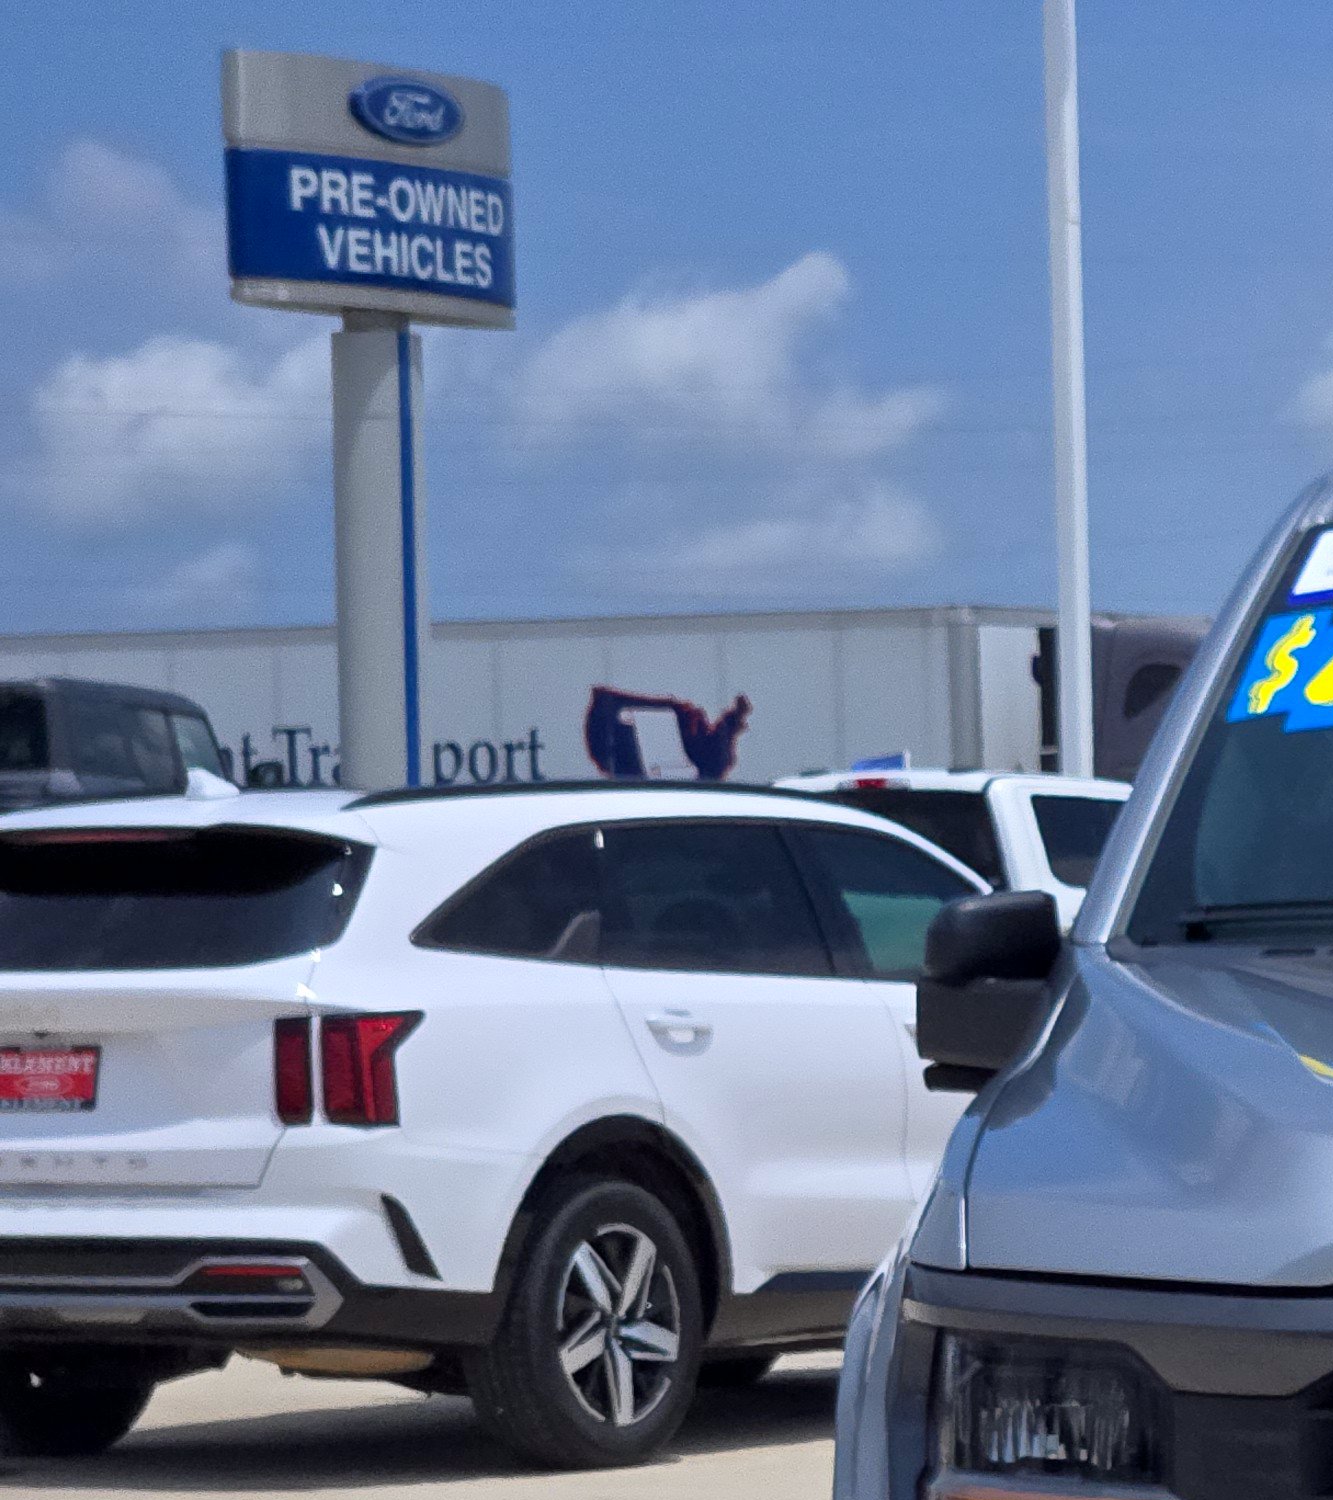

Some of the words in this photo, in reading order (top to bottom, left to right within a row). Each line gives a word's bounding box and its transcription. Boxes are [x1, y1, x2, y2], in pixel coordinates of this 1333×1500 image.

[382, 91, 446, 132] Ford
[288, 164, 505, 237] PRE-OWNED
[316, 222, 494, 289] VEHICLES
